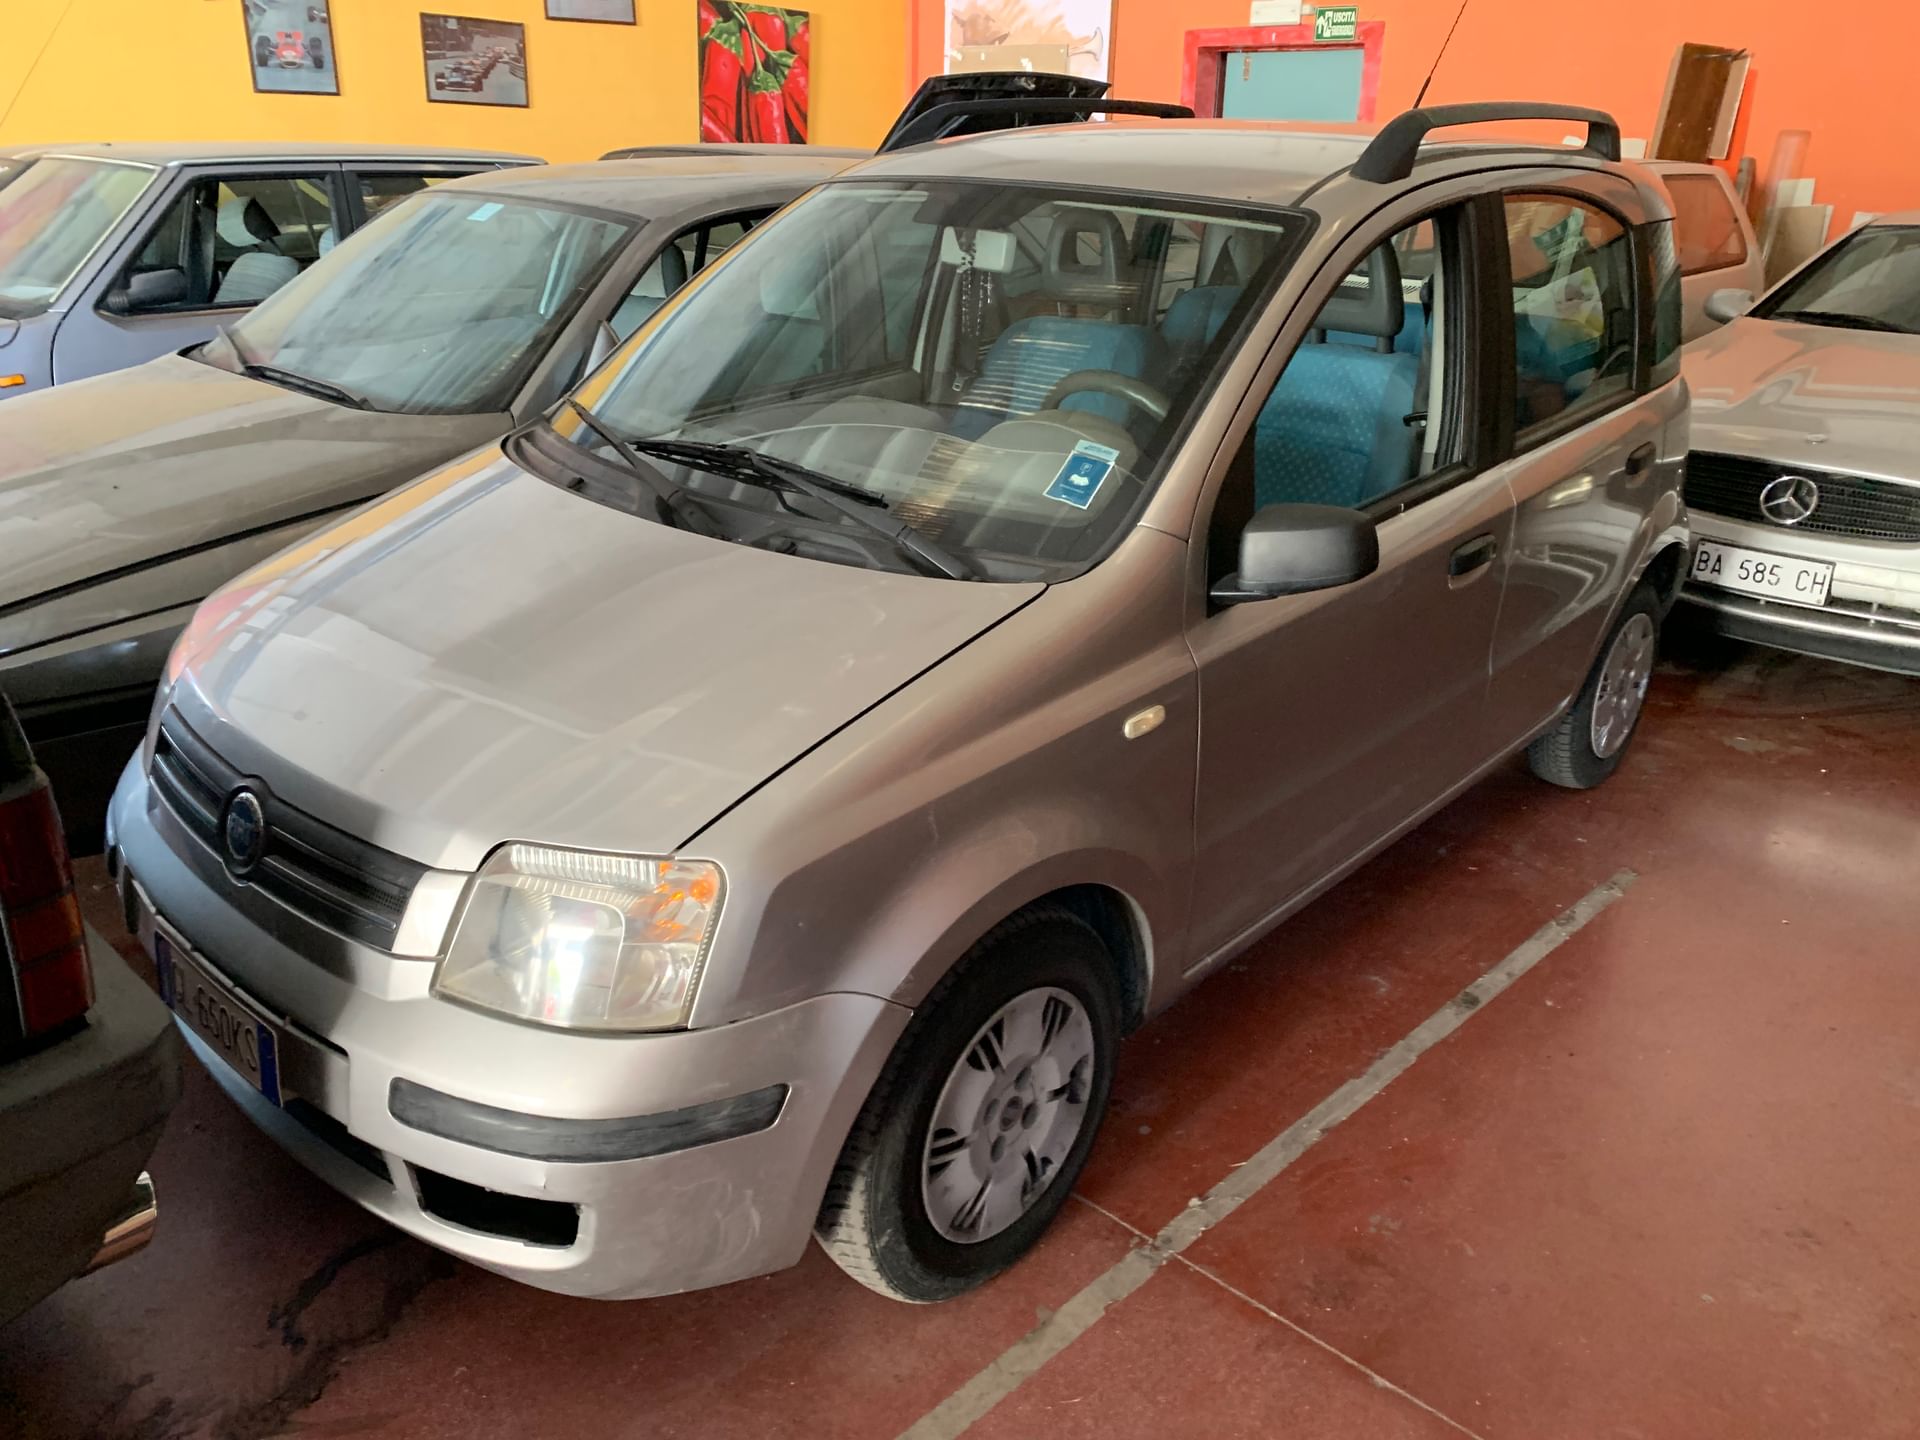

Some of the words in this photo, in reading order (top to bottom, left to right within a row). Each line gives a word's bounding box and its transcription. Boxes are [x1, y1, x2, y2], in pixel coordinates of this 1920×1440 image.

[1333, 11, 1355, 23] USCITA
[1696, 550, 1722, 576] BA
[1738, 559, 1783, 587] 585
[1795, 569, 1827, 595] CH
